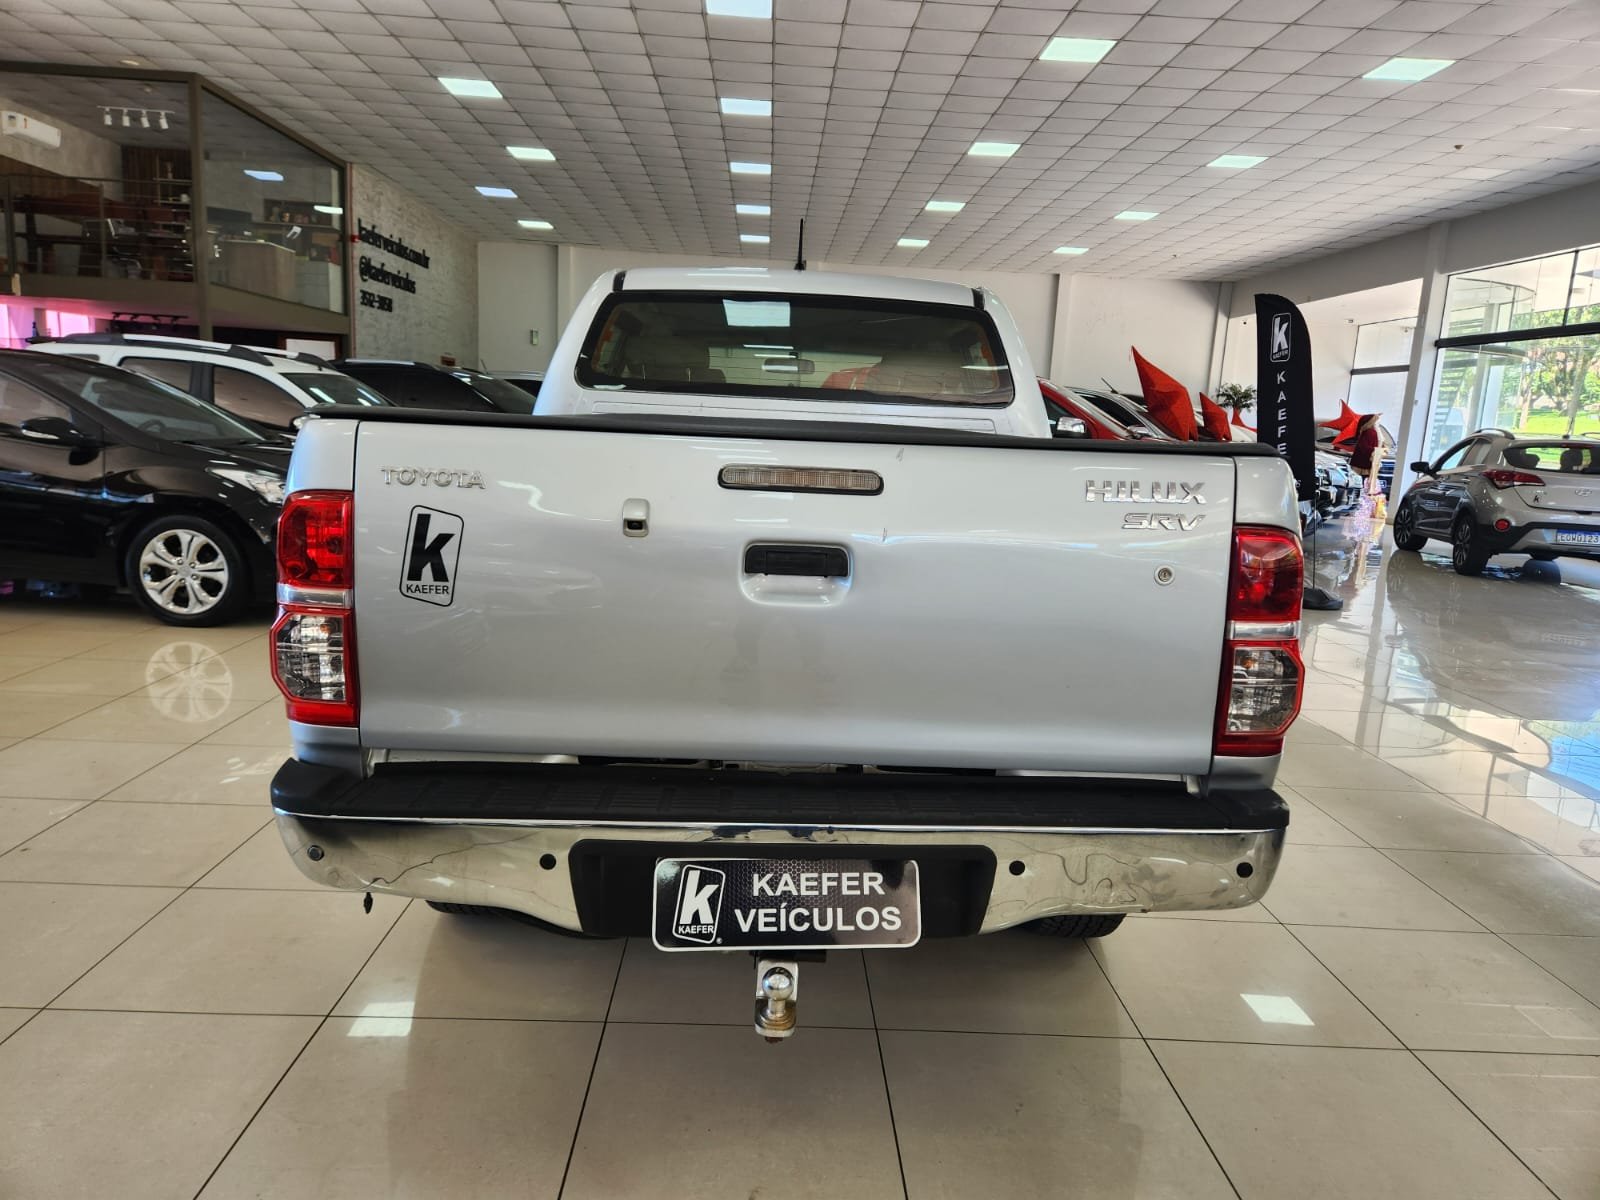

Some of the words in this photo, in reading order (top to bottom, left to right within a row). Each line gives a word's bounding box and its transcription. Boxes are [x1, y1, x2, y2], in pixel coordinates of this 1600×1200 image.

[381, 468, 486, 490] TOYOTA
[1086, 479, 1207, 505] HILUX
[1122, 512, 1206, 531] SRV
[406, 584, 450, 595] KAEFER
[753, 872, 885, 897] KAEFER
[735, 903, 902, 932] VEÍCULOS
[678, 925, 715, 934] KAEFER
